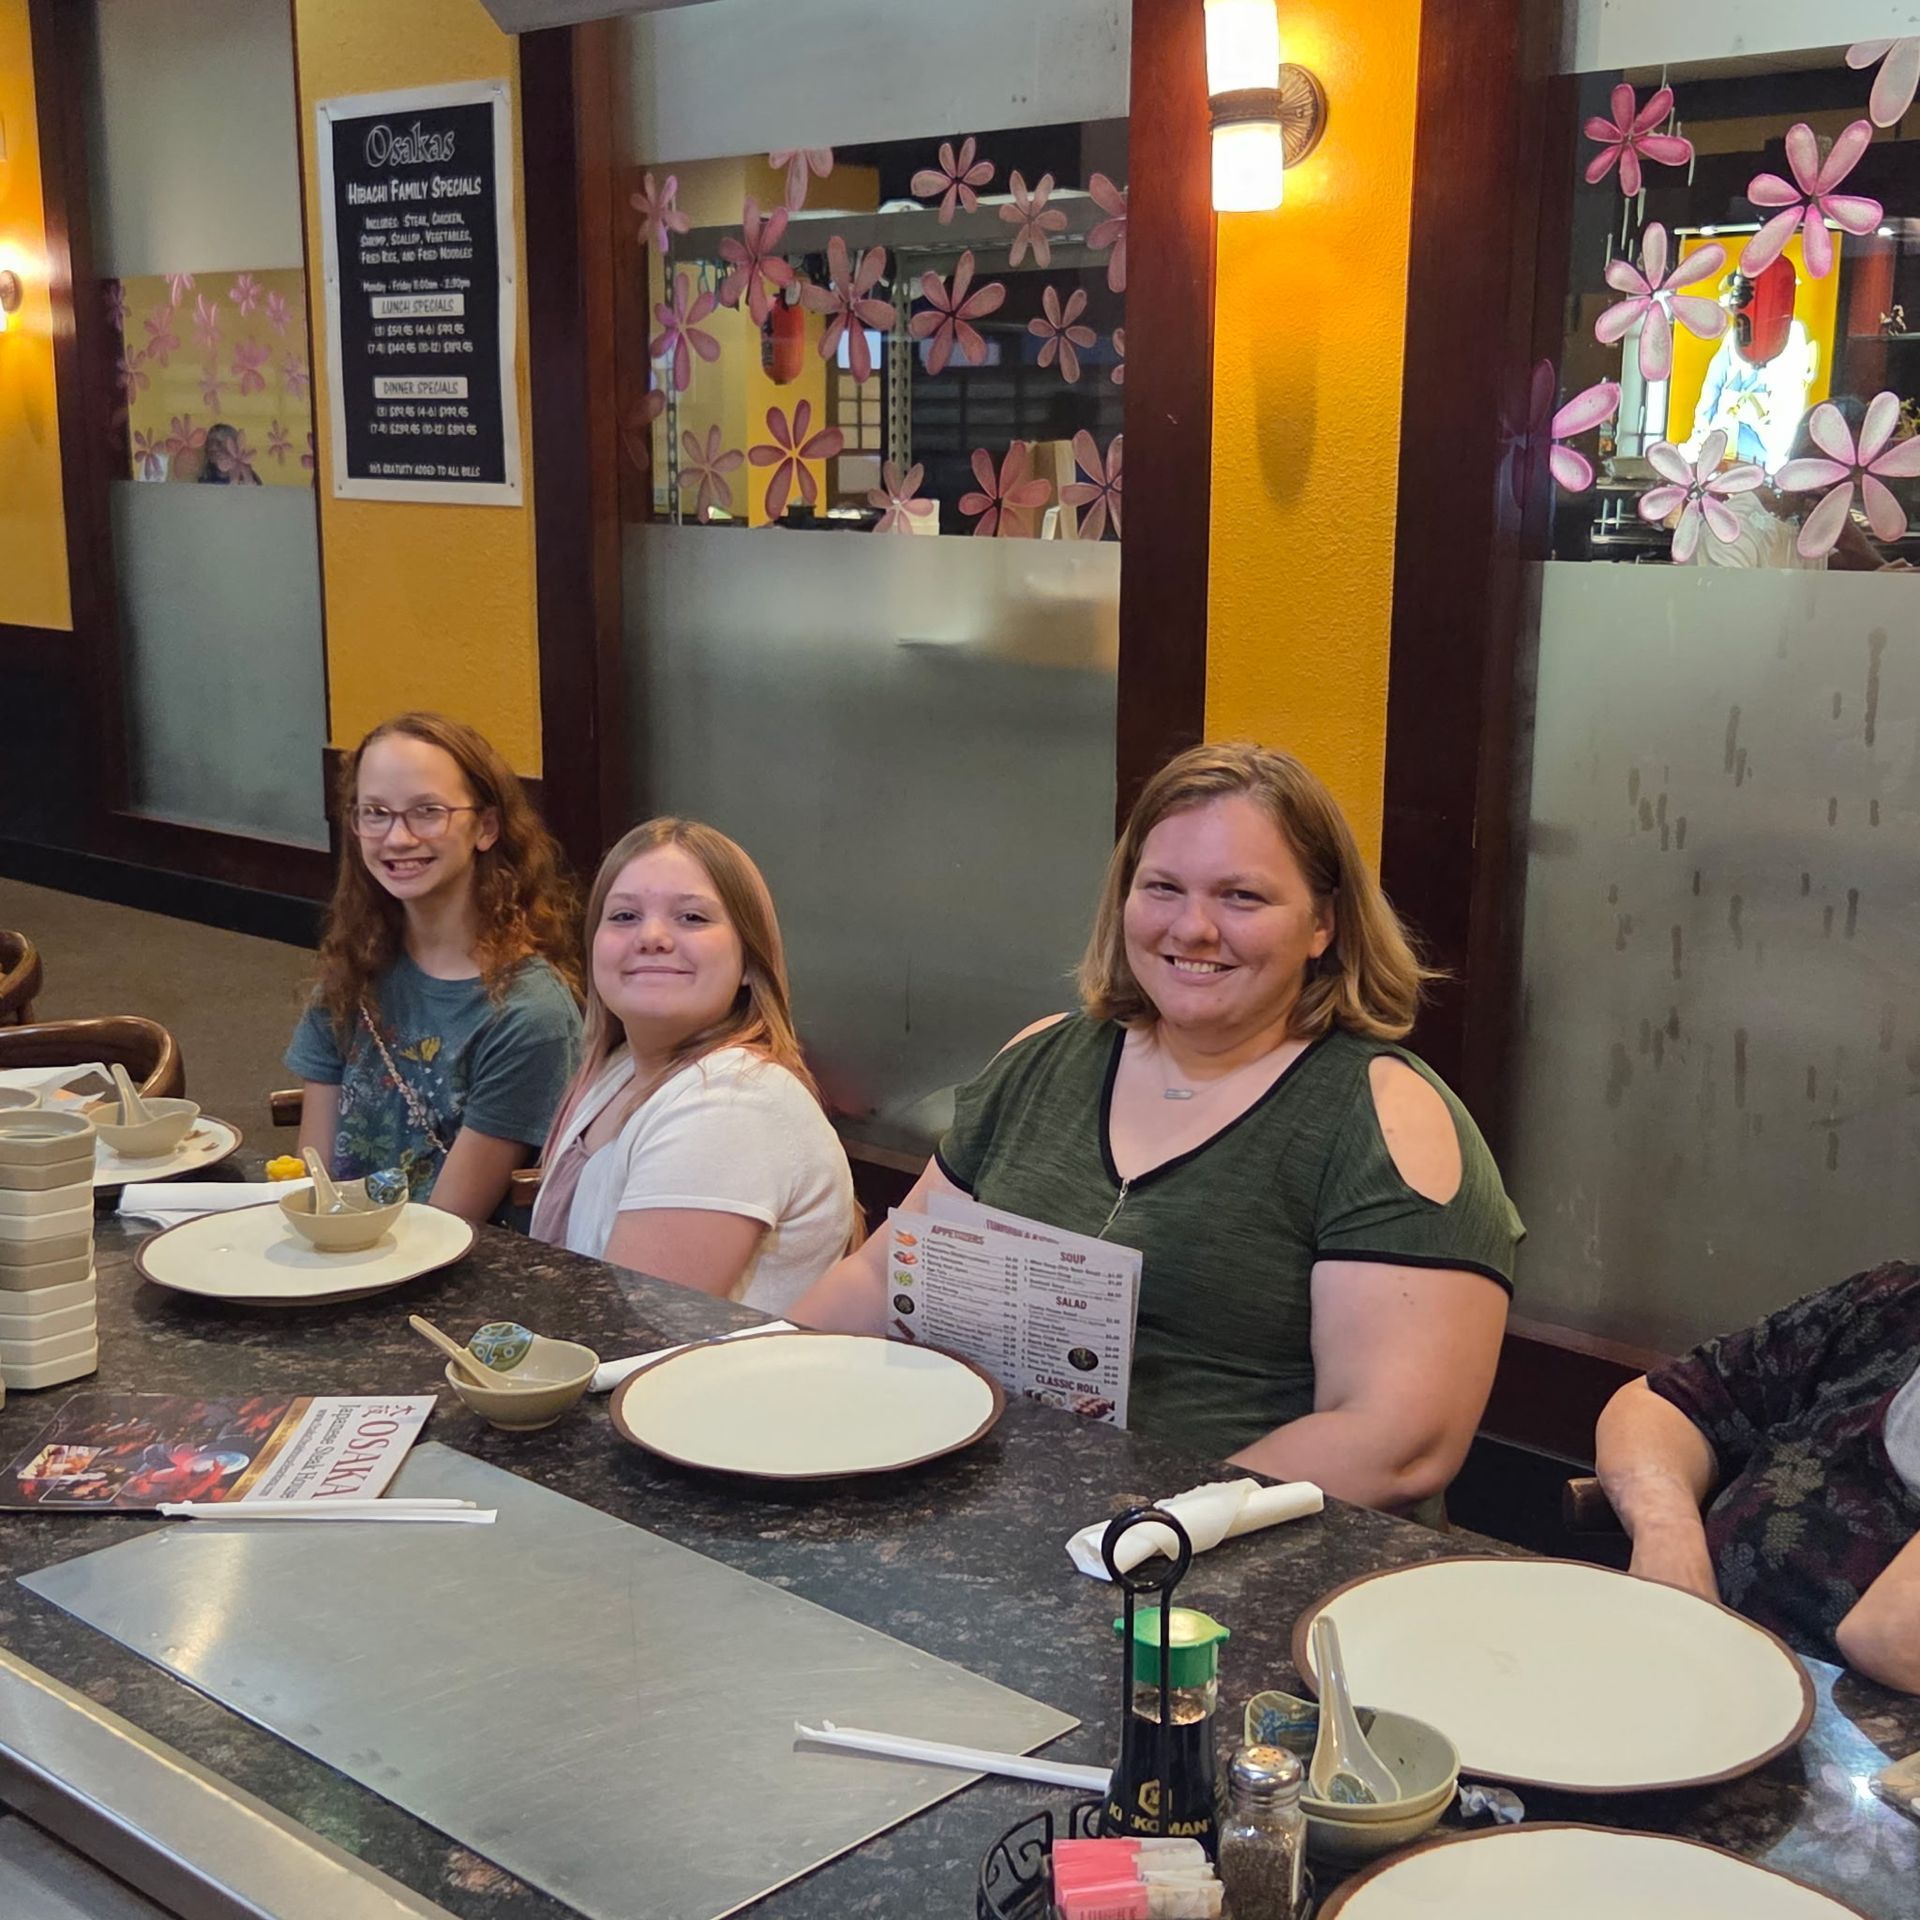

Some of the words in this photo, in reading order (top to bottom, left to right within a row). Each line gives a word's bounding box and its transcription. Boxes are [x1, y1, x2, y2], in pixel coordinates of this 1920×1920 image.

[348, 181, 388, 205] HIBACHI
[391, 179, 428, 202] FAMILY
[431, 176, 482, 199] SPECIALS
[440, 246, 473, 260] NOODLES
[382, 299, 410, 315] LUNCH
[412, 297, 454, 313] SPECIALS
[383, 381, 413, 395] DINNER
[417, 380, 459, 395] SPECIALS
[1060, 1251, 1087, 1265] SOUP
[1056, 1295, 1088, 1310] SALAD
[1035, 1373, 1076, 1392] CLASSIC
[1076, 1382, 1102, 1396] ROLL
[319, 1404, 361, 1446] Japanese
[301, 1446, 335, 1471] Steak
[312, 1420, 400, 1499] OSAKA
[279, 1471, 318, 1500] House
